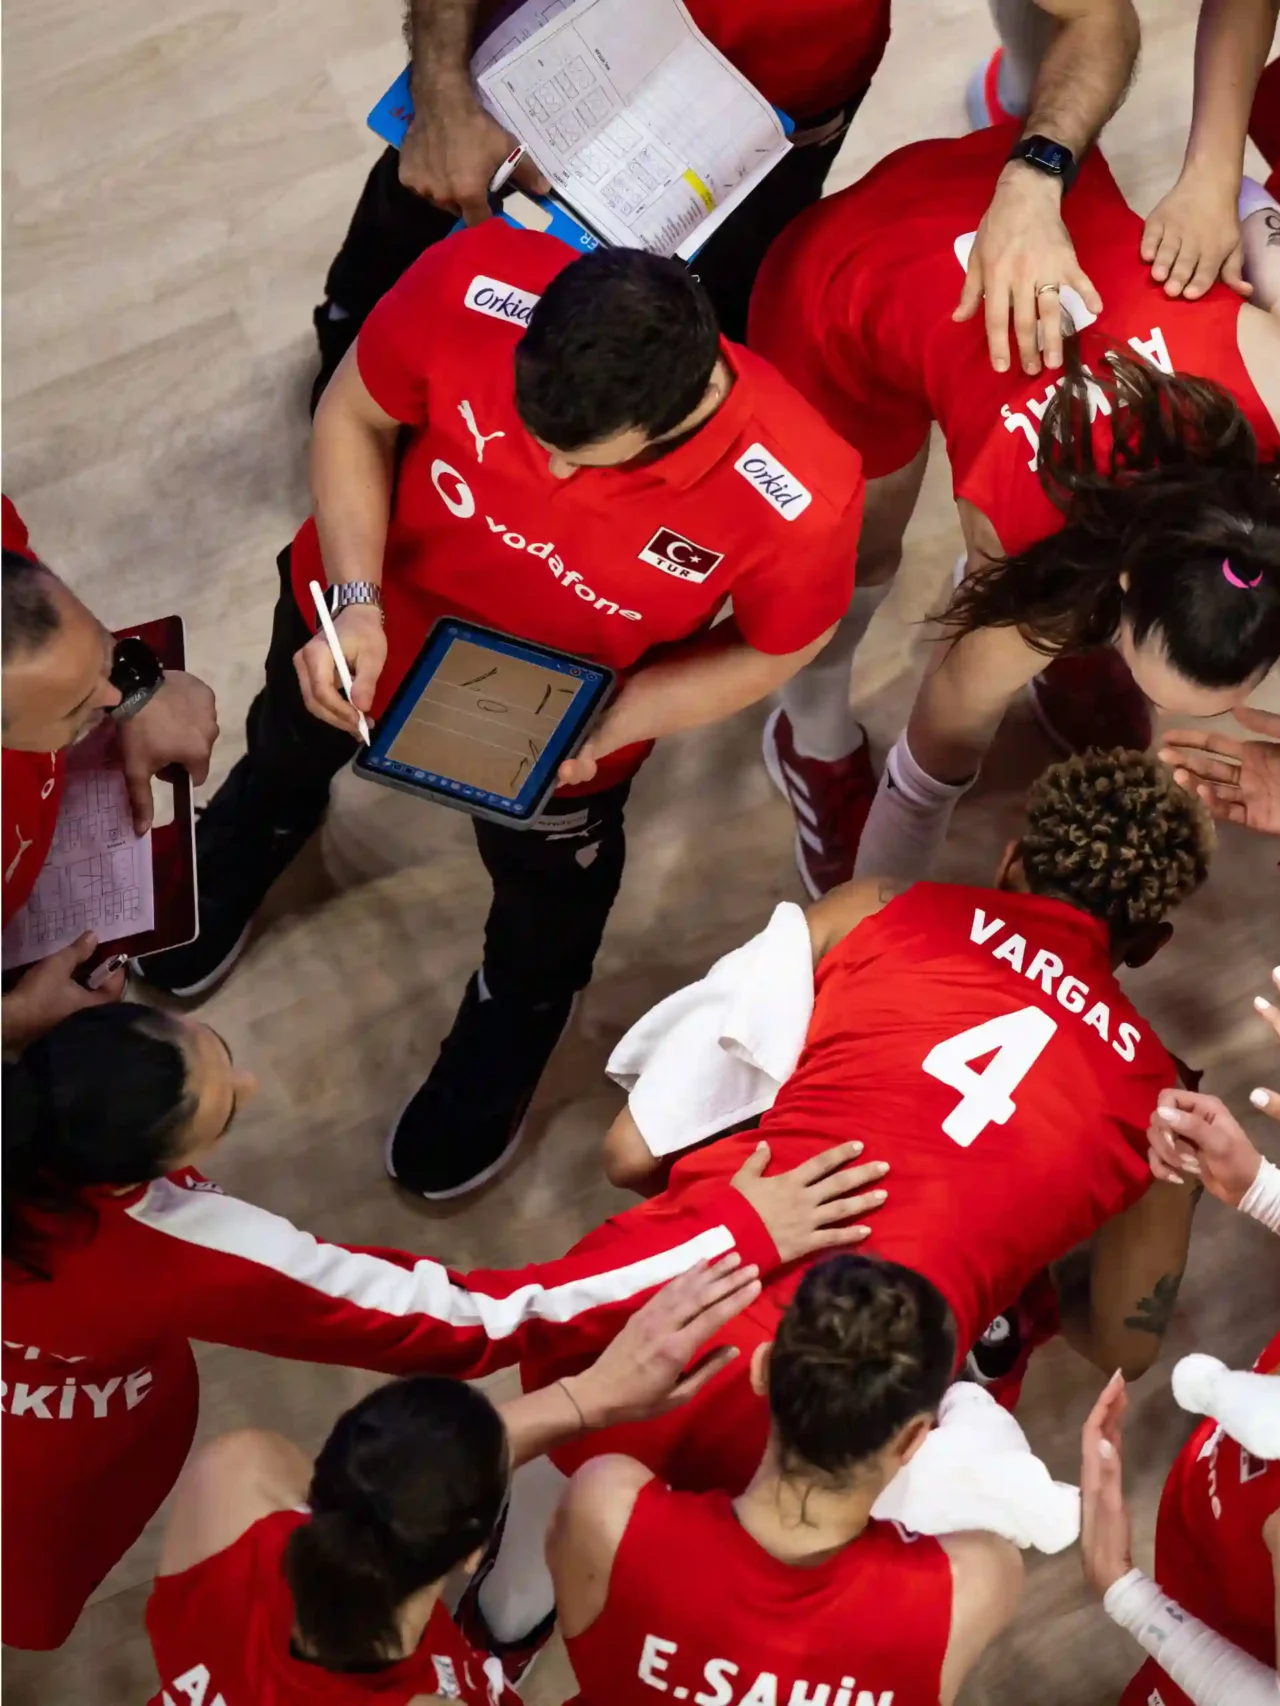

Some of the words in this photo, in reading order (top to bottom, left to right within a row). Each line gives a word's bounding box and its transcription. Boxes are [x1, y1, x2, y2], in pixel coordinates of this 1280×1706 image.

[743, 458, 803, 508] Orkid
[485, 515, 643, 622] vodafone
[654, 557, 692, 577] TUR
[969, 908, 1142, 1063] VARGAS
[922, 1005, 1058, 1148] 4
